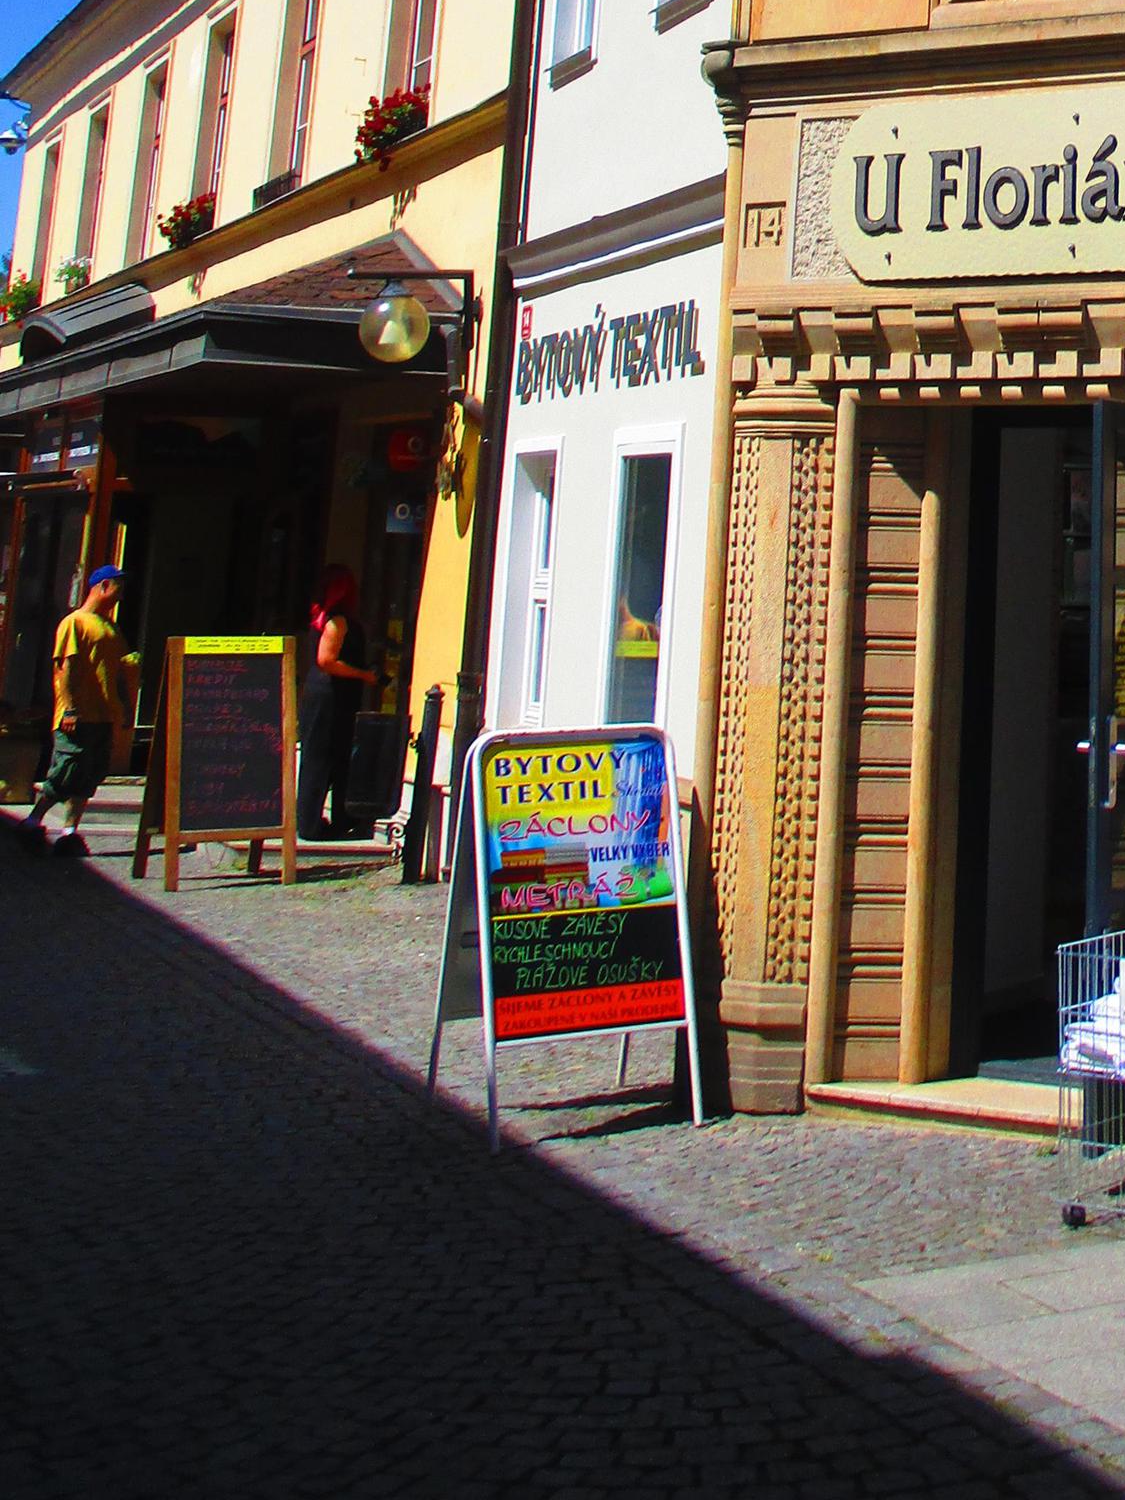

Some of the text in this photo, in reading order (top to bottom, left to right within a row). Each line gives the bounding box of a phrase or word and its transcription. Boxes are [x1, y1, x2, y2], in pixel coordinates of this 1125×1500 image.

[853, 154, 902, 235] U
[750, 209, 782, 247] 14
[515, 299, 702, 397] BYTOVÝ TEXTIL
[496, 779, 607, 805] TEXTIL
[500, 811, 650, 843] ZÁCLONY
[501, 871, 638, 908] METRÁŽ
[493, 914, 552, 942] KUSOVÉ
[597, 956, 663, 986] OSUŠKY
